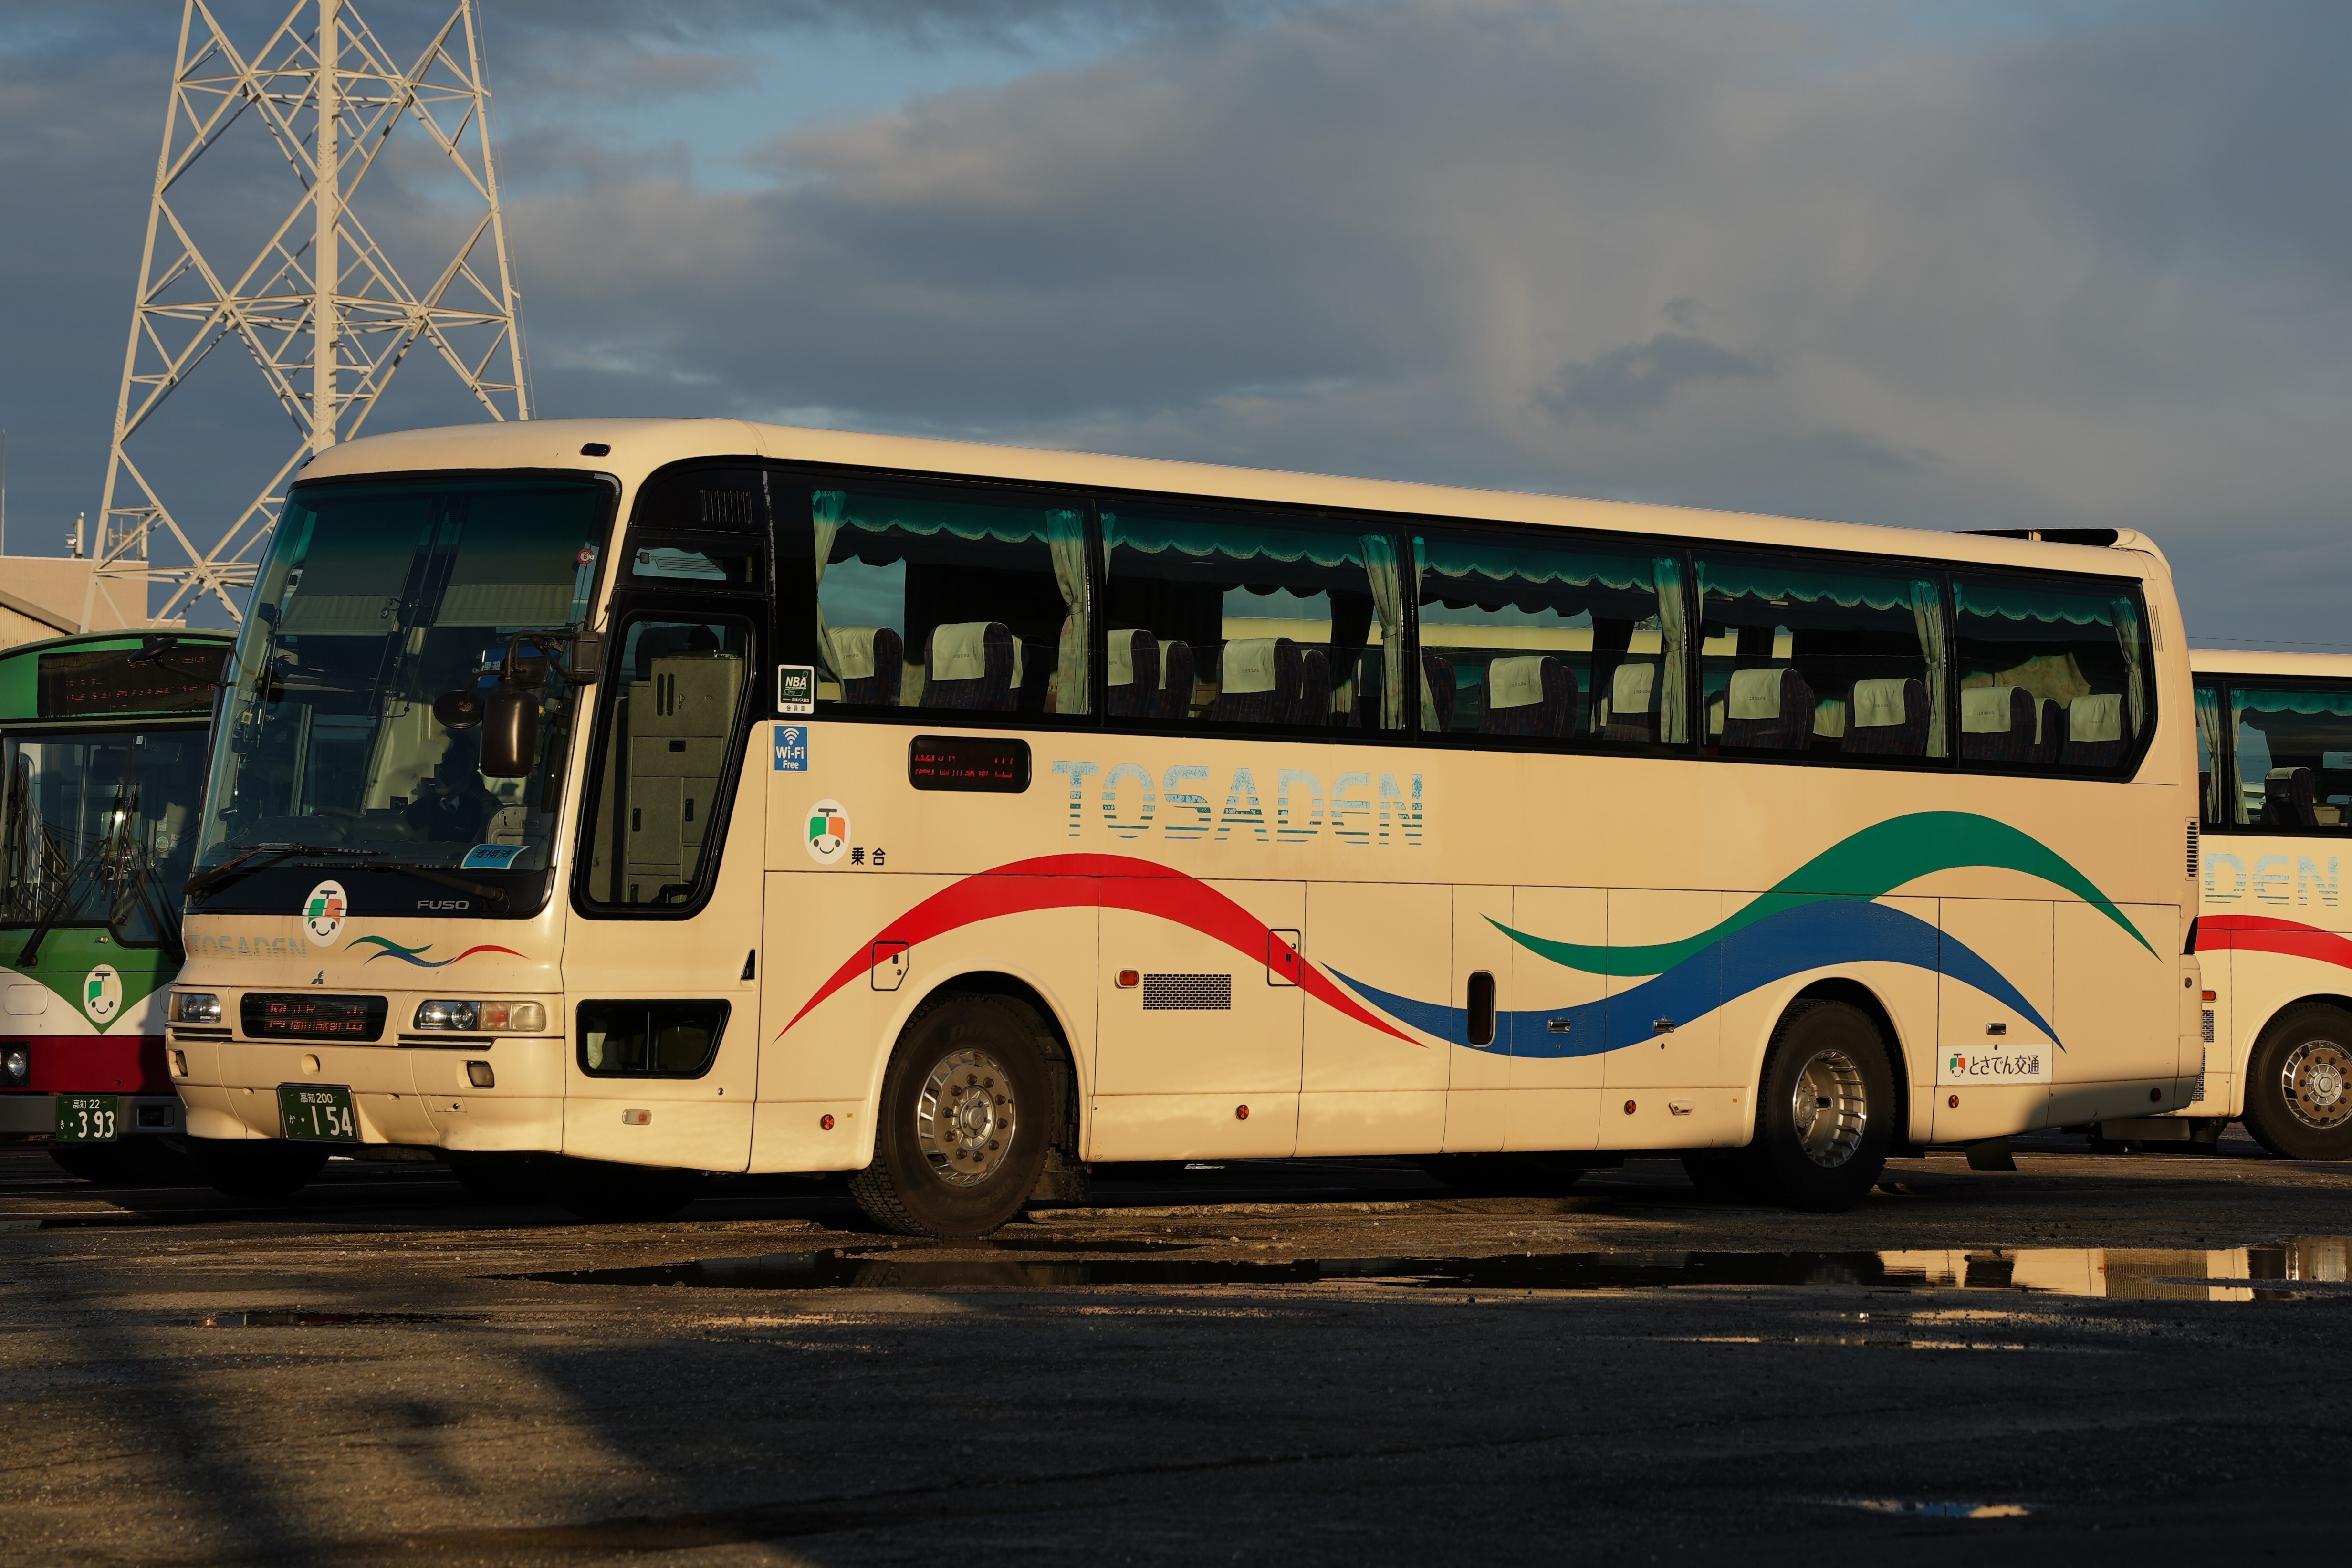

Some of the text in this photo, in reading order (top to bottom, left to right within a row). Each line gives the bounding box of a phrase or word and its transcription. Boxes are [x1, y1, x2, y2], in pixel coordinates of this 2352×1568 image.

[785, 676, 807, 687] NBA
[776, 746, 804, 759] Wi-Fi
[783, 760, 799, 769] Free
[1052, 760, 1423, 846] TOSADEN
[471, 849, 514, 859] 清掃済
[851, 847, 886, 866] 乗合
[417, 900, 470, 909] FUSO
[189, 934, 308, 961] TOSADEN
[1969, 1055, 2040, 1075] とさでん交通
[73, 1099, 100, 1109] 高知 22
